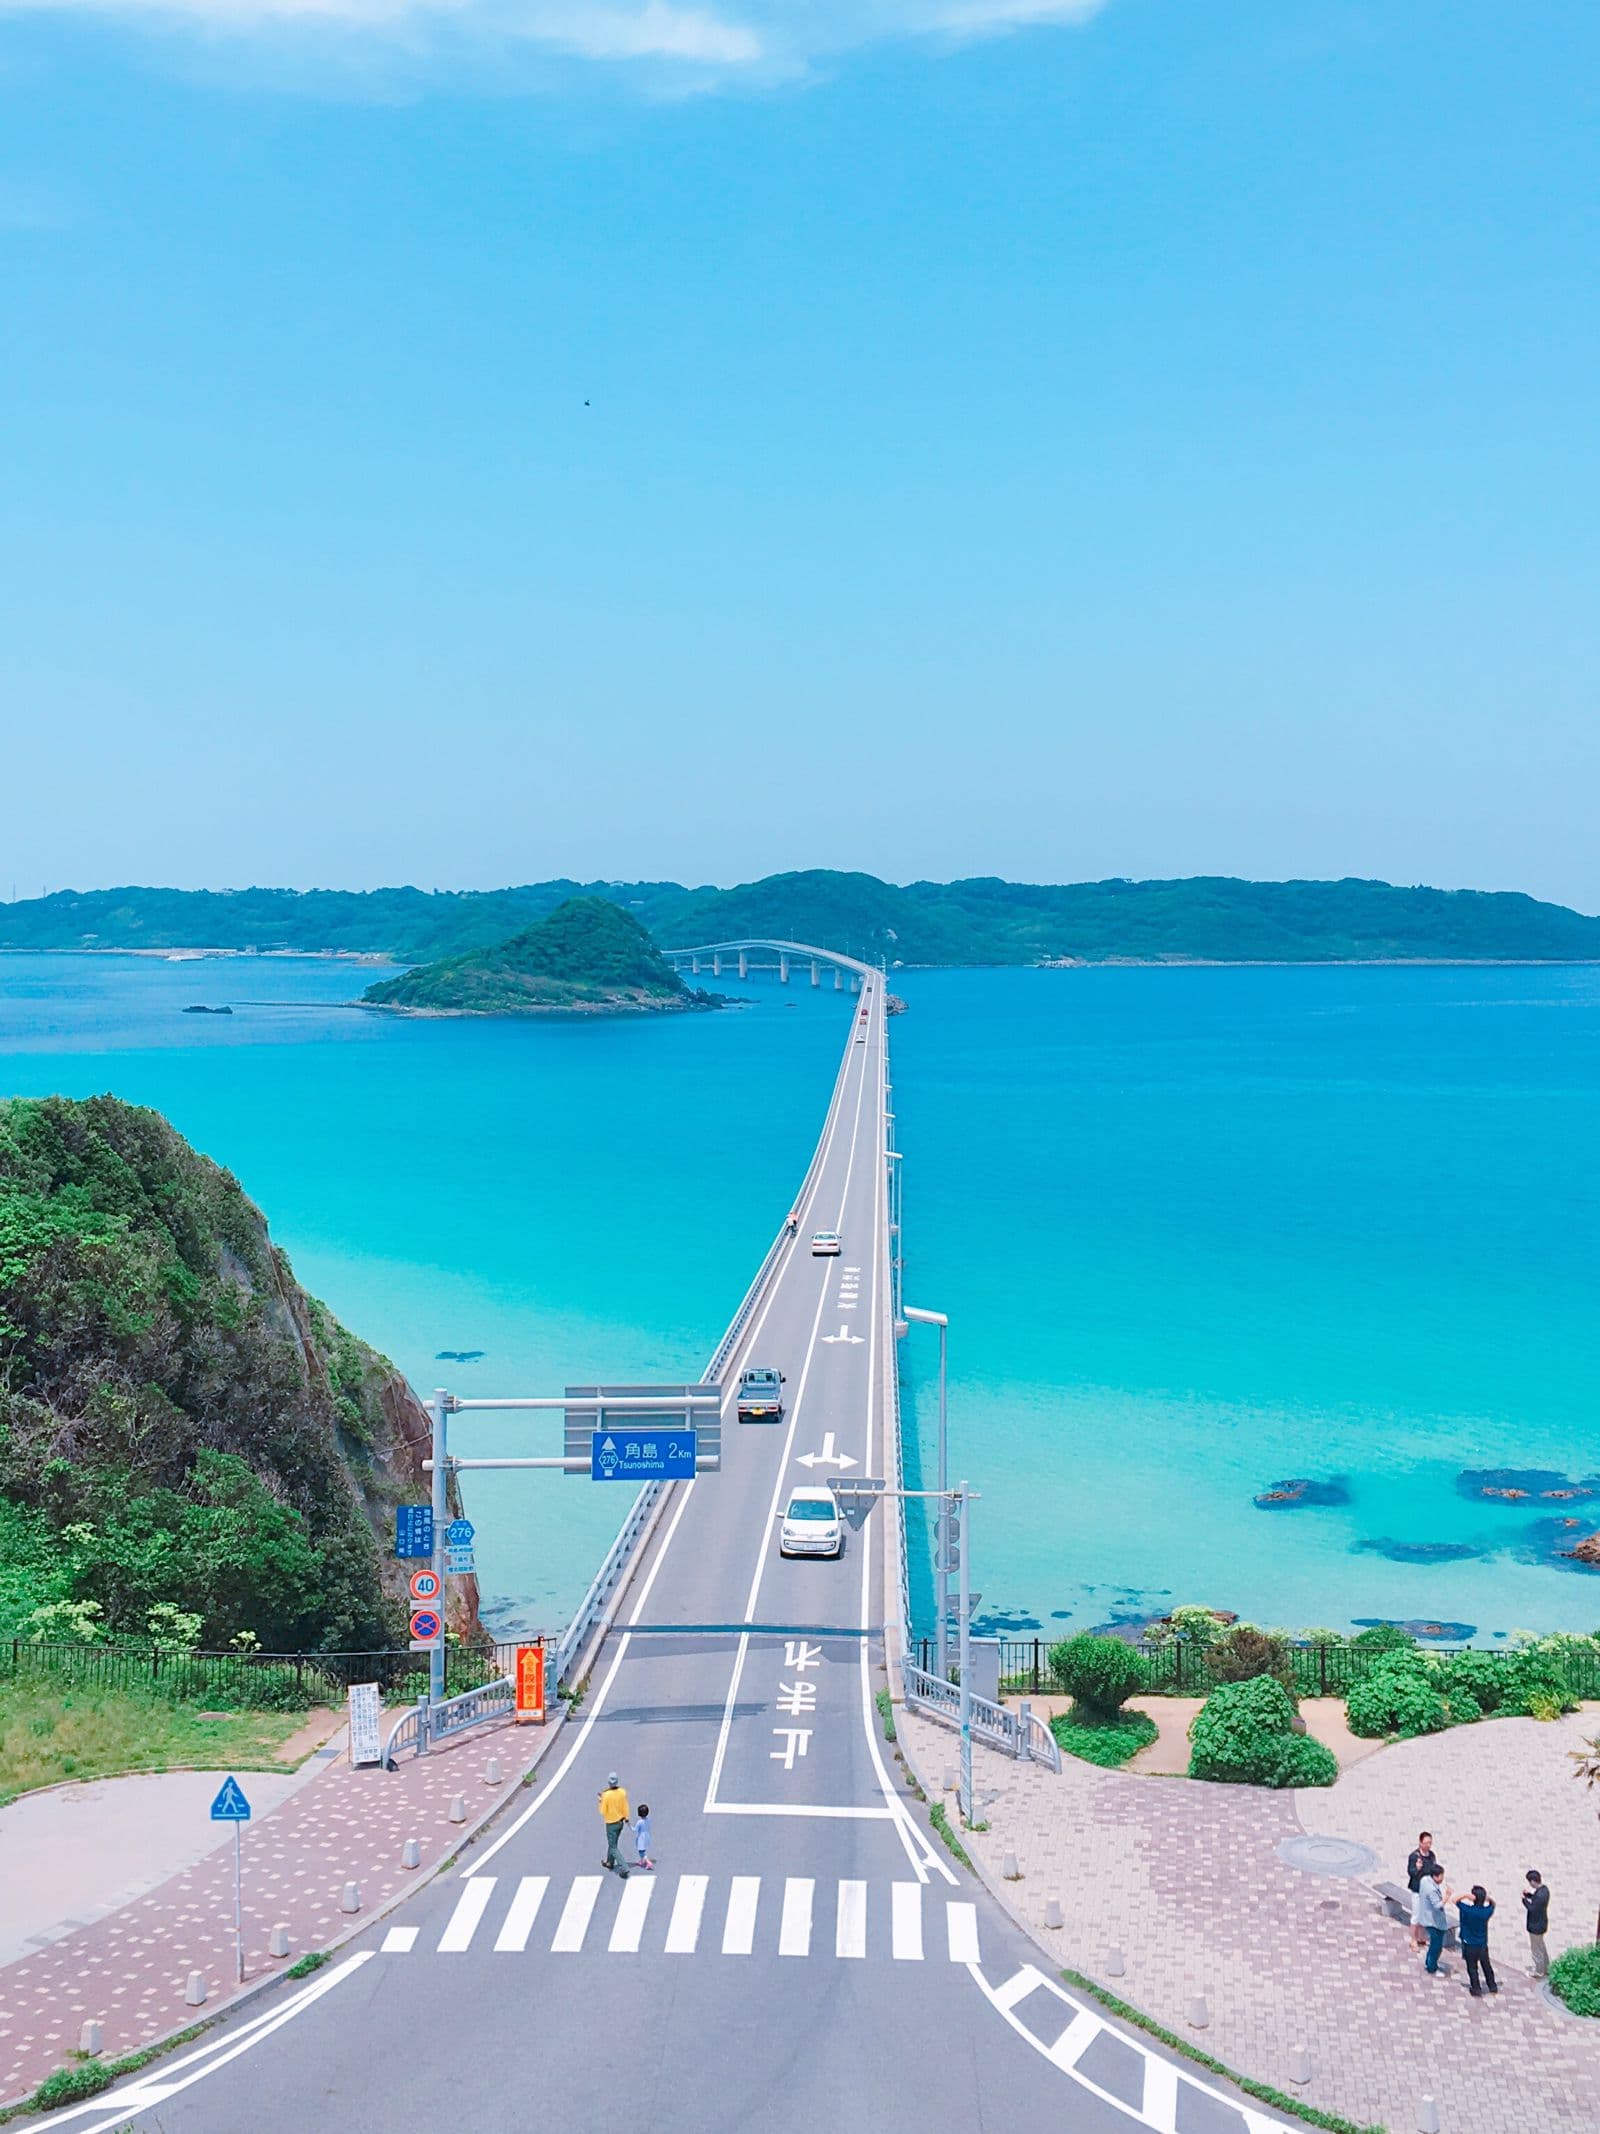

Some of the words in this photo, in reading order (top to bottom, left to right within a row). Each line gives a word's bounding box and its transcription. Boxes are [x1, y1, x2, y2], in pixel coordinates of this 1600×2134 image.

[624, 1442, 658, 1459] 角島
[602, 1455, 616, 1465] 276
[619, 1459, 664, 1470] Tsunoshima
[450, 1527, 472, 1538] 276
[417, 1578, 434, 1592] 40
[769, 1640, 822, 1770] 止まれ
